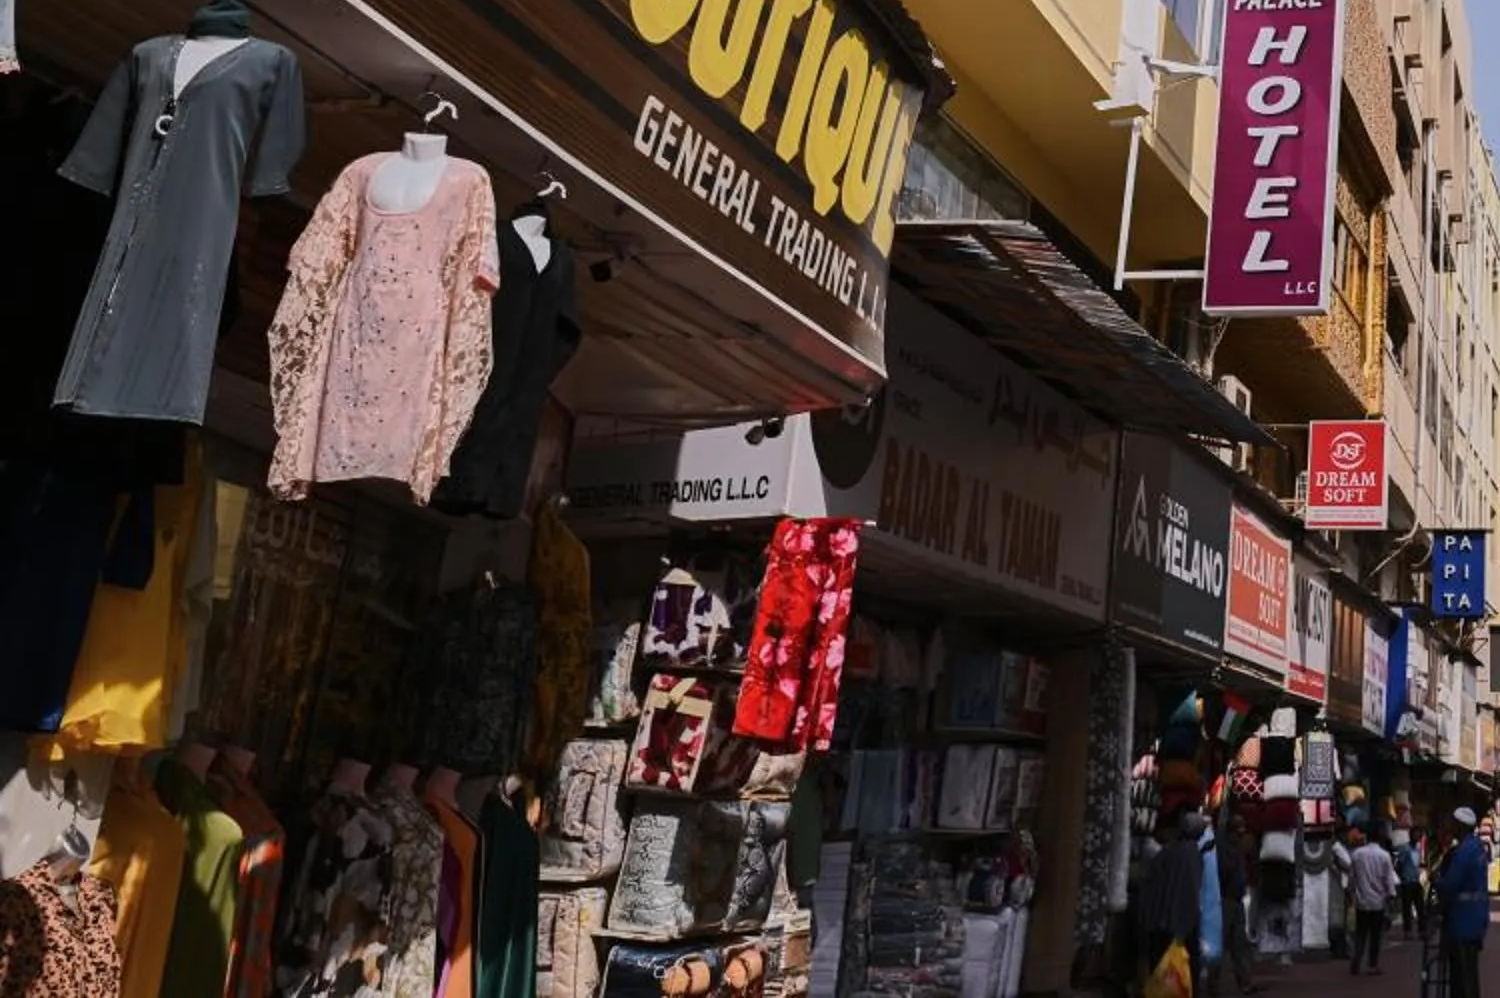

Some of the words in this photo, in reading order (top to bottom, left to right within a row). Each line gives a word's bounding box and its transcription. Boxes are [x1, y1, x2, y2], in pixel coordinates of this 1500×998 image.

[1241, 25, 1307, 272] HOTEL
[633, 95, 762, 234] GENERAL
[764, 196, 857, 306] TRADING
[652, 478, 722, 505] TRADING
[727, 475, 769, 500] L.L.C
[877, 435, 961, 556] BADAR
[1315, 472, 1377, 486] DREAM
[1324, 488, 1367, 502] SOFT
[1155, 519, 1224, 598] MELANO
[1232, 530, 1278, 596] DREAM
